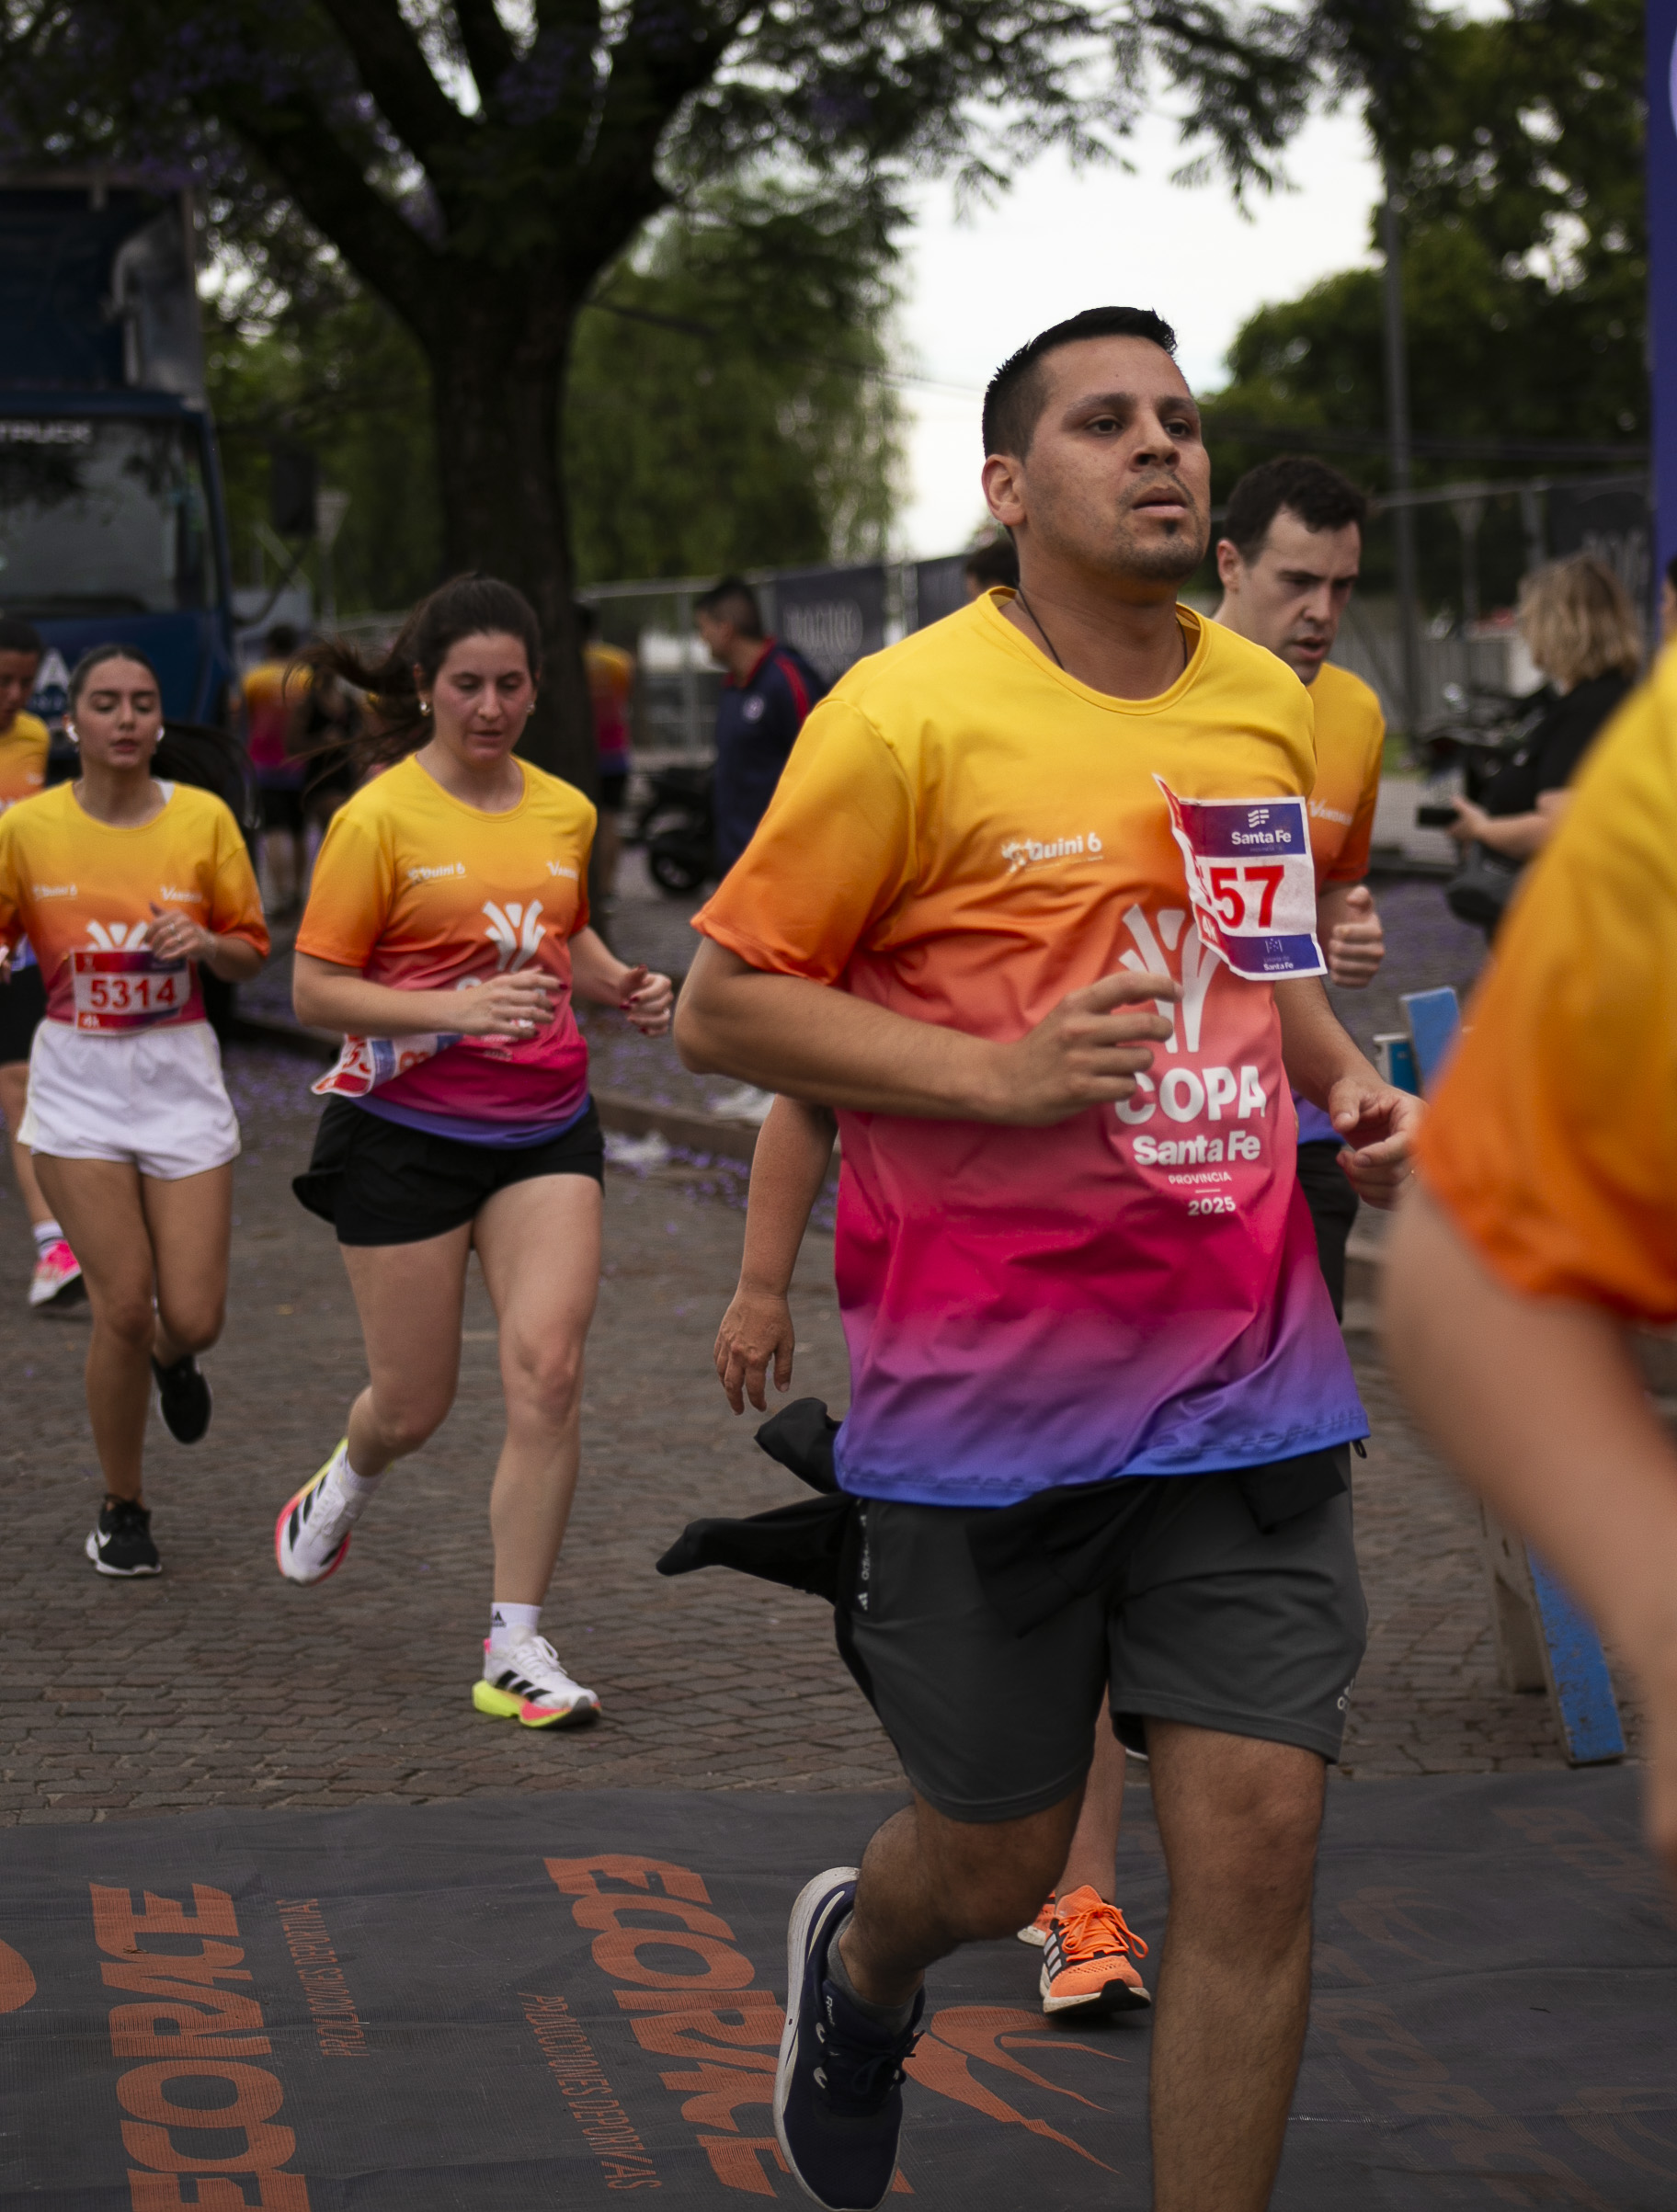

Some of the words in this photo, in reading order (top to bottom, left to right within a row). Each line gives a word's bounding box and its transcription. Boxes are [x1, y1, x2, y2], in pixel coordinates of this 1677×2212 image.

[1029, 835, 1084, 861] Quini
[1087, 831, 1102, 853] 6
[1231, 831, 1274, 845] Santa
[1275, 829, 1292, 843] Fe
[91, 977, 176, 1009] 5314
[1114, 1066, 1267, 1125] COPA
[1132, 1135, 1224, 1166] Santa
[1227, 1130, 1261, 1161] Fe
[1168, 1171, 1232, 1185] PROVINCIA
[1187, 1196, 1236, 1216] 2025
